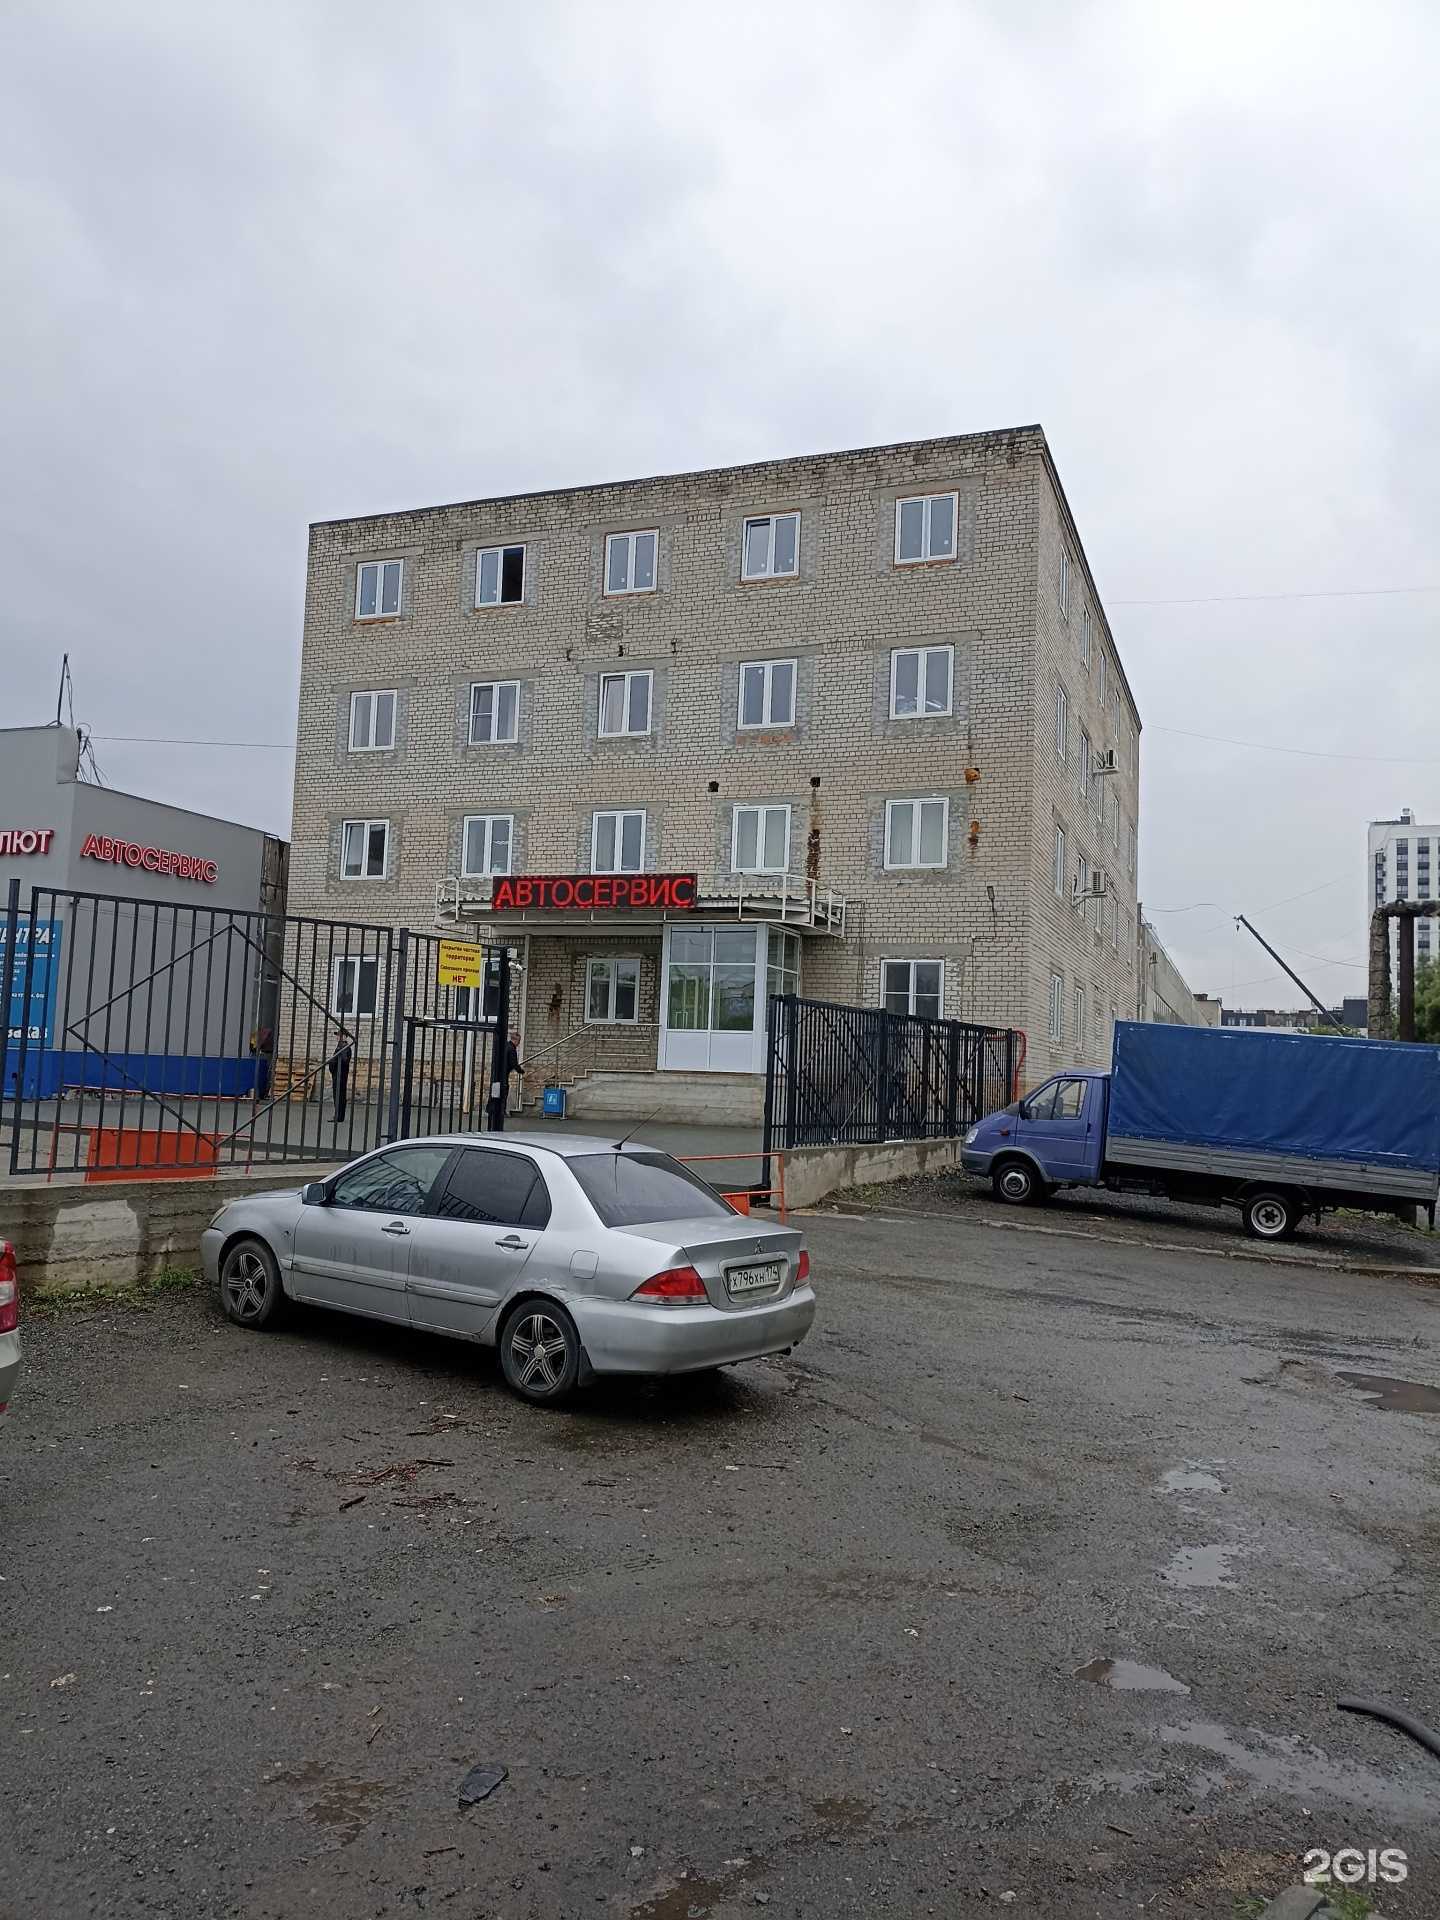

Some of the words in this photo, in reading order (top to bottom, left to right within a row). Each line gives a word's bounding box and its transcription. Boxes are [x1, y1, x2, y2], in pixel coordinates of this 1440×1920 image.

[81, 833, 219, 883] АВТОСЕРВИС
[495, 878, 695, 907] АВТОСЕРВИС
[452, 975, 466, 983] НЕТ
